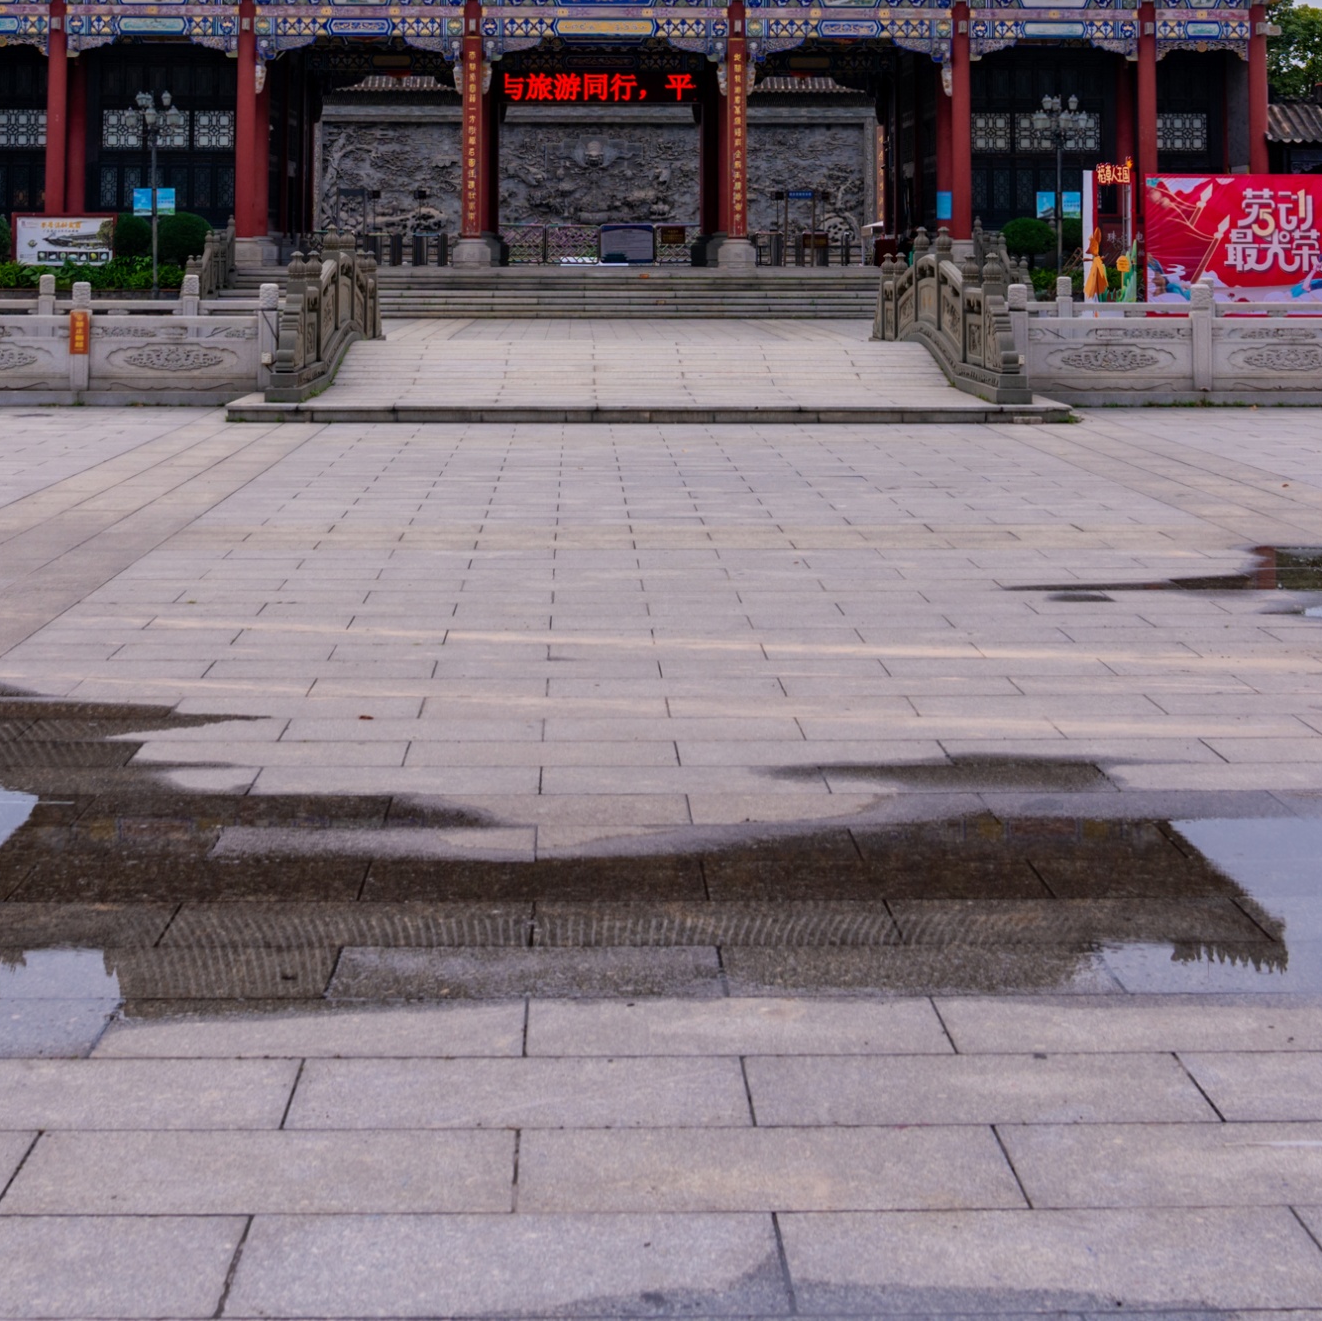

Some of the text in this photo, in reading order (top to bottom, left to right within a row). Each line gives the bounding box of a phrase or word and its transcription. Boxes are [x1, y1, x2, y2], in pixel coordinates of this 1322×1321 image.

[1097, 165, 1130, 184] 稻草人王国
